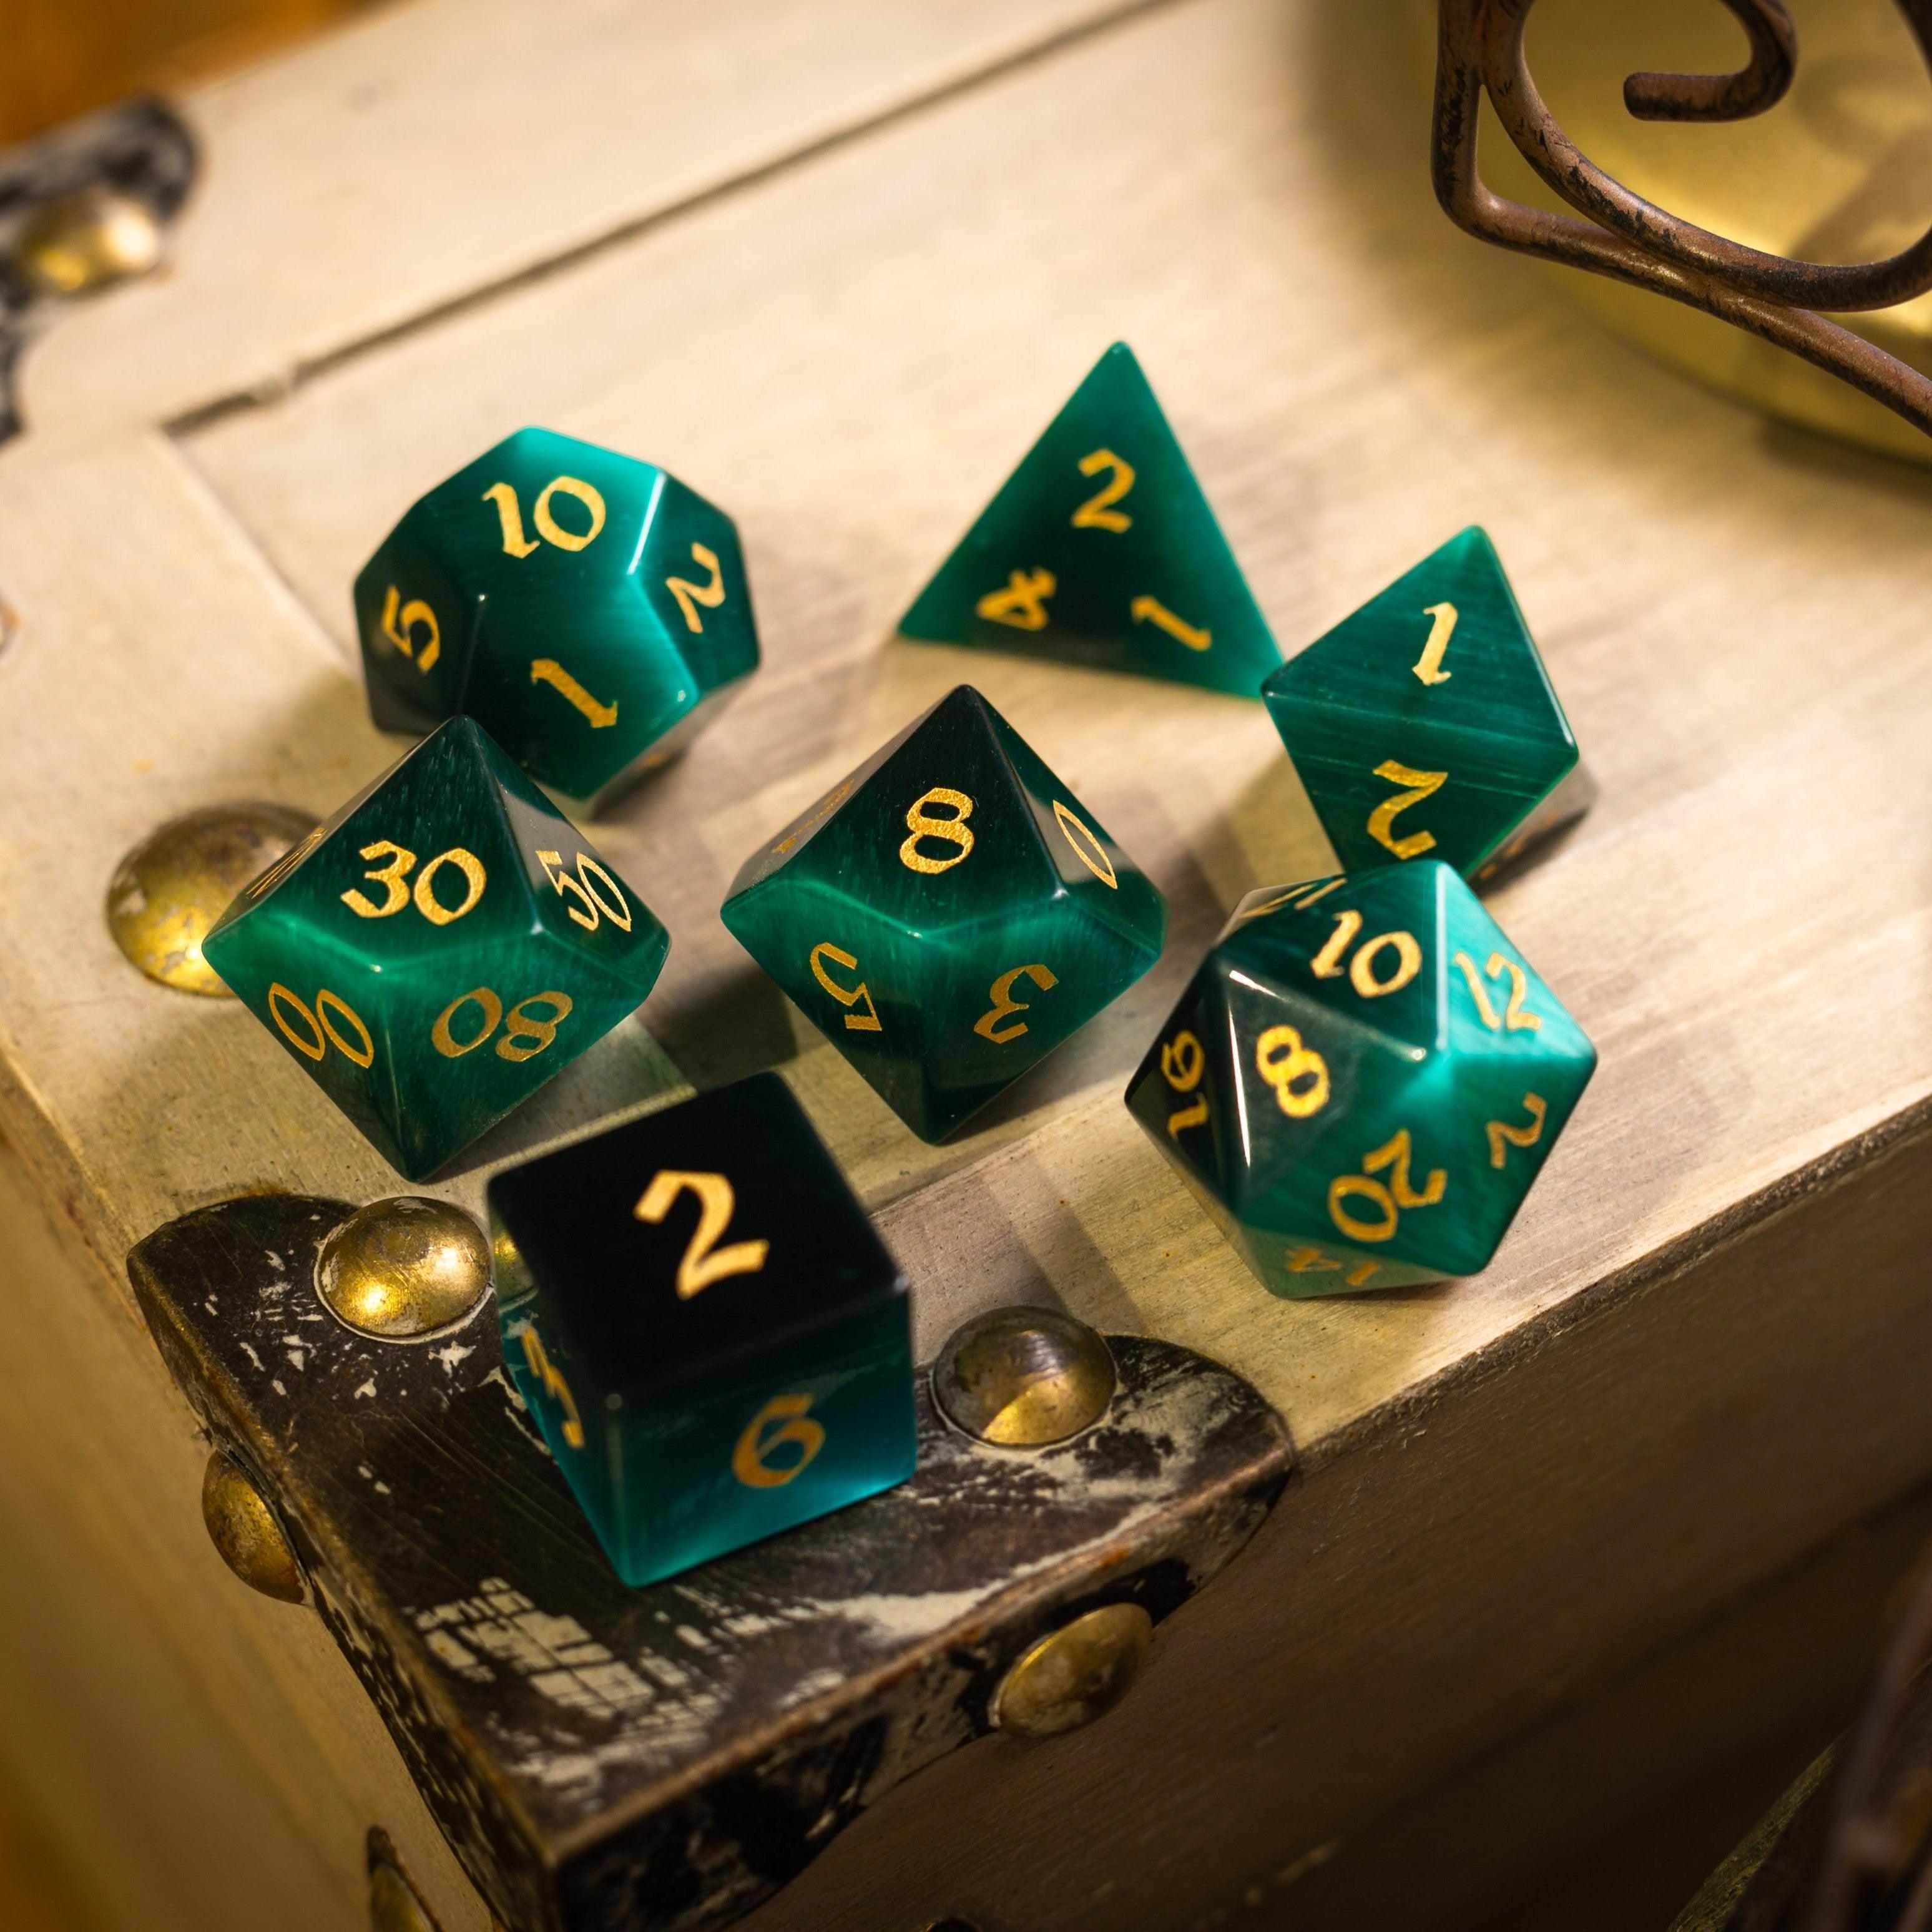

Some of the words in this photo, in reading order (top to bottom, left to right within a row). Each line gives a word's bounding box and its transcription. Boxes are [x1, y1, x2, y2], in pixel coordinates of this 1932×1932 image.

[481, 476, 606, 559] 10
[1071, 448, 1136, 534] 2
[382, 584, 441, 675] 5
[665, 542, 726, 634] 2
[976, 567, 1056, 630] 4
[1131, 596, 1212, 651] 1
[1412, 602, 1458, 685] 1
[530, 657, 618, 728] 1
[898, 786, 975, 875] 8
[1052, 800, 1119, 889] 0
[1367, 760, 1448, 860] 2
[340, 840, 487, 925] 30
[536, 850, 632, 931] 50
[810, 942, 882, 1031] 5
[1311, 910, 1422, 998] 10
[1454, 952, 1542, 1032] 12
[268, 983, 374, 1068] 00
[432, 987, 573, 1061] 80
[973, 964, 1059, 1044] 3
[1256, 1025, 1330, 1118] 8
[1486, 1092, 1547, 1169] 2
[1328, 1129, 1447, 1242] 20
[633, 1169, 770, 1301] 2
[732, 1394, 825, 1488] 6
